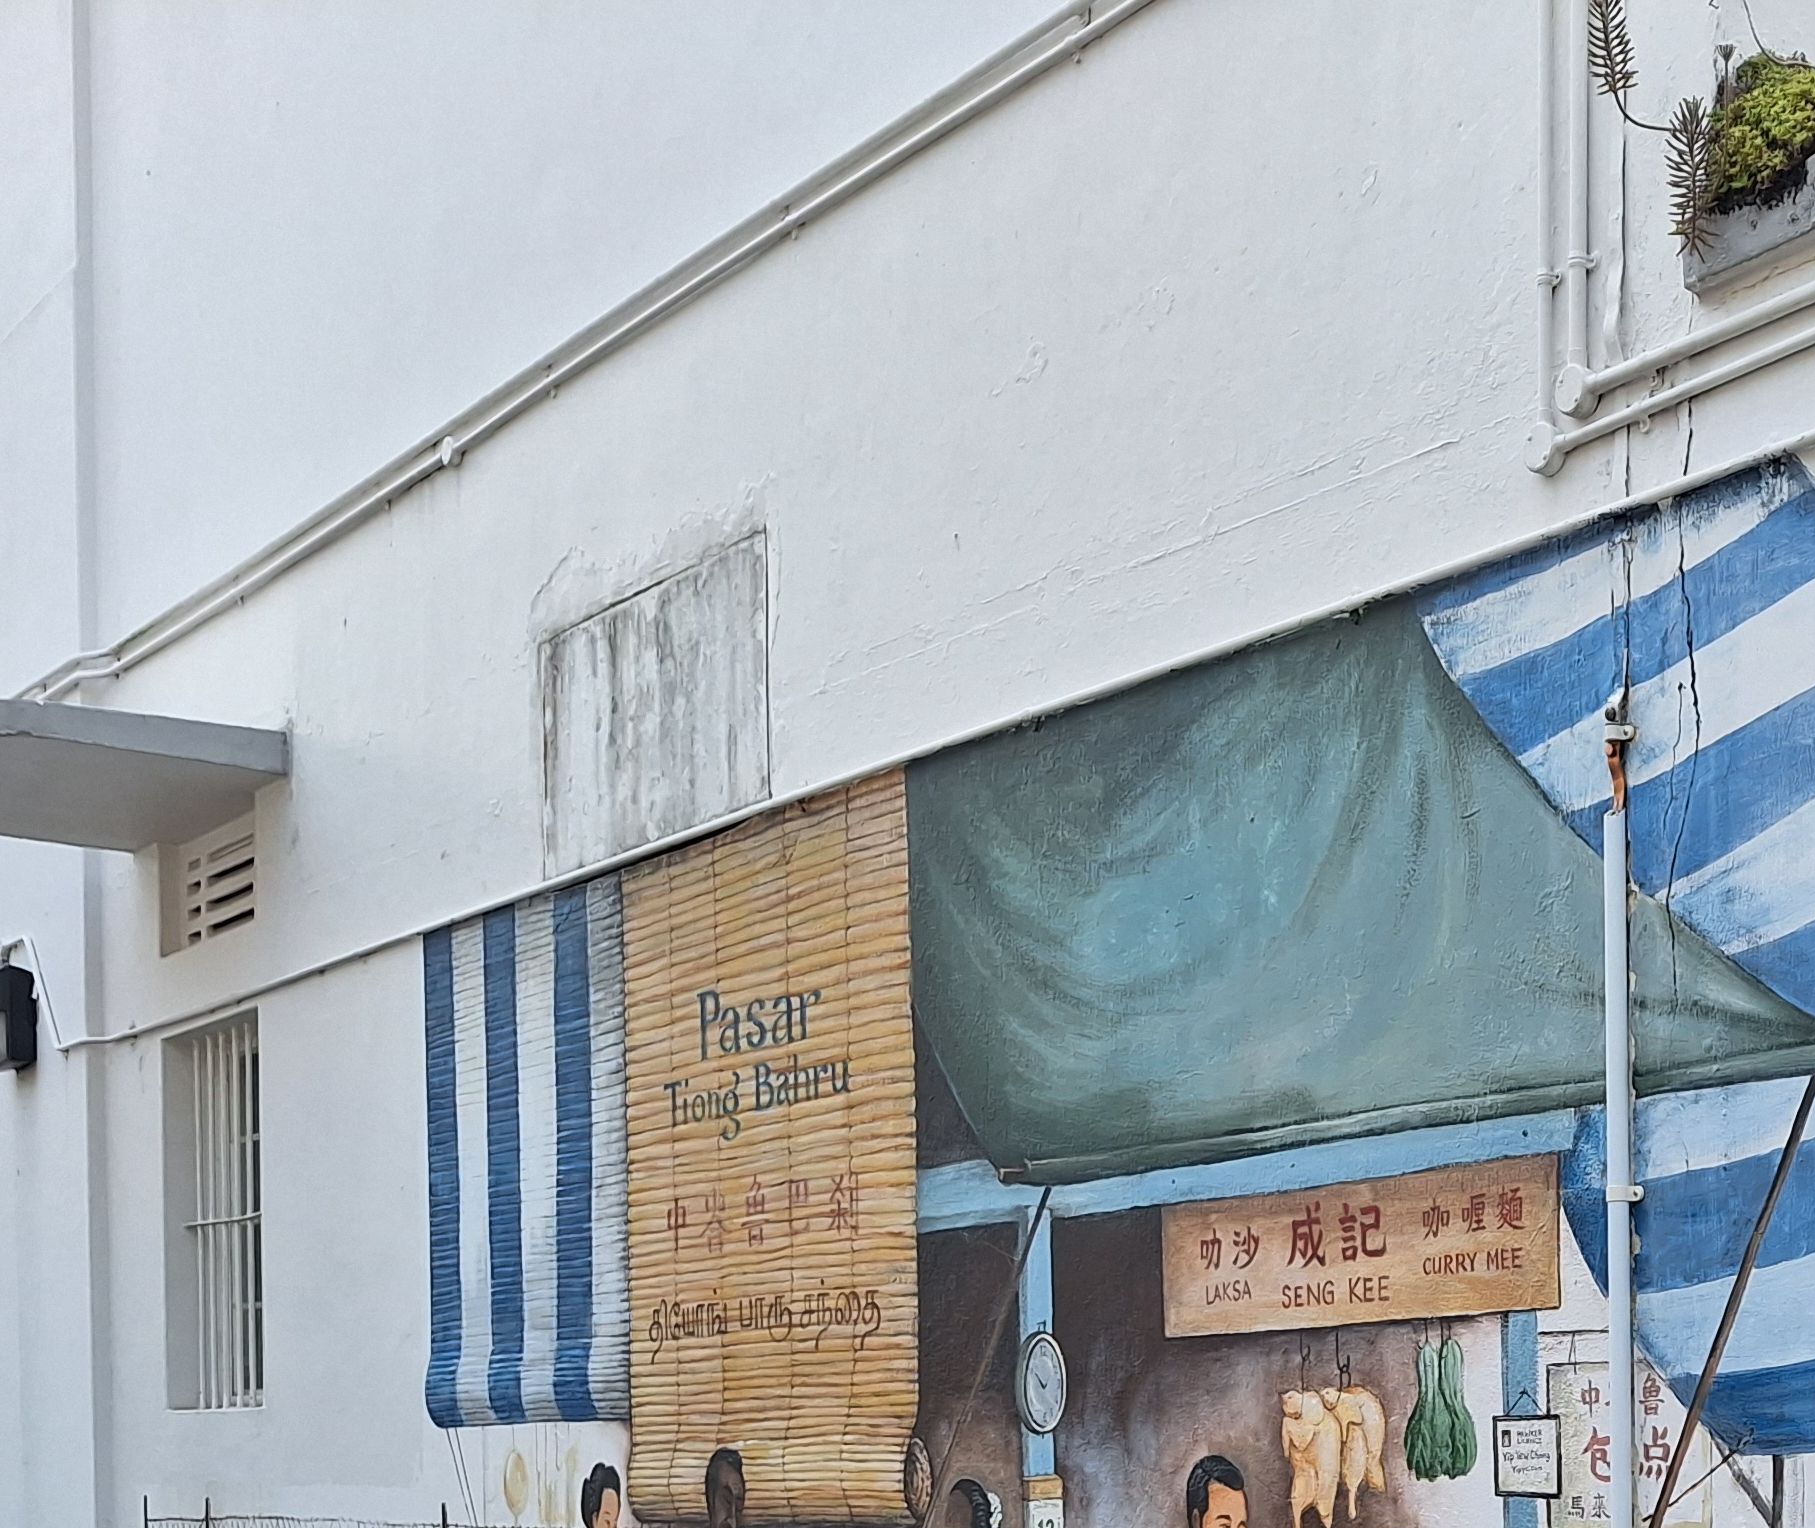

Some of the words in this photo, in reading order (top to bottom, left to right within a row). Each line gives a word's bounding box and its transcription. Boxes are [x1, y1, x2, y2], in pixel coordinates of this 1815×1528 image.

[697, 989, 822, 1061] Pasar
[664, 1070, 740, 1141] Tiong
[753, 1054, 851, 1113] Bahru
[1200, 1226, 1260, 1271] 叻沙
[1286, 1200, 1388, 1268] 成記
[1205, 1280, 1252, 1305] LAKSA
[1281, 1279, 1335, 1309] SENG
[1348, 1275, 1391, 1303] KEE
[1422, 1251, 1478, 1276] CURRY
[1486, 1247, 1524, 1272] MEE
